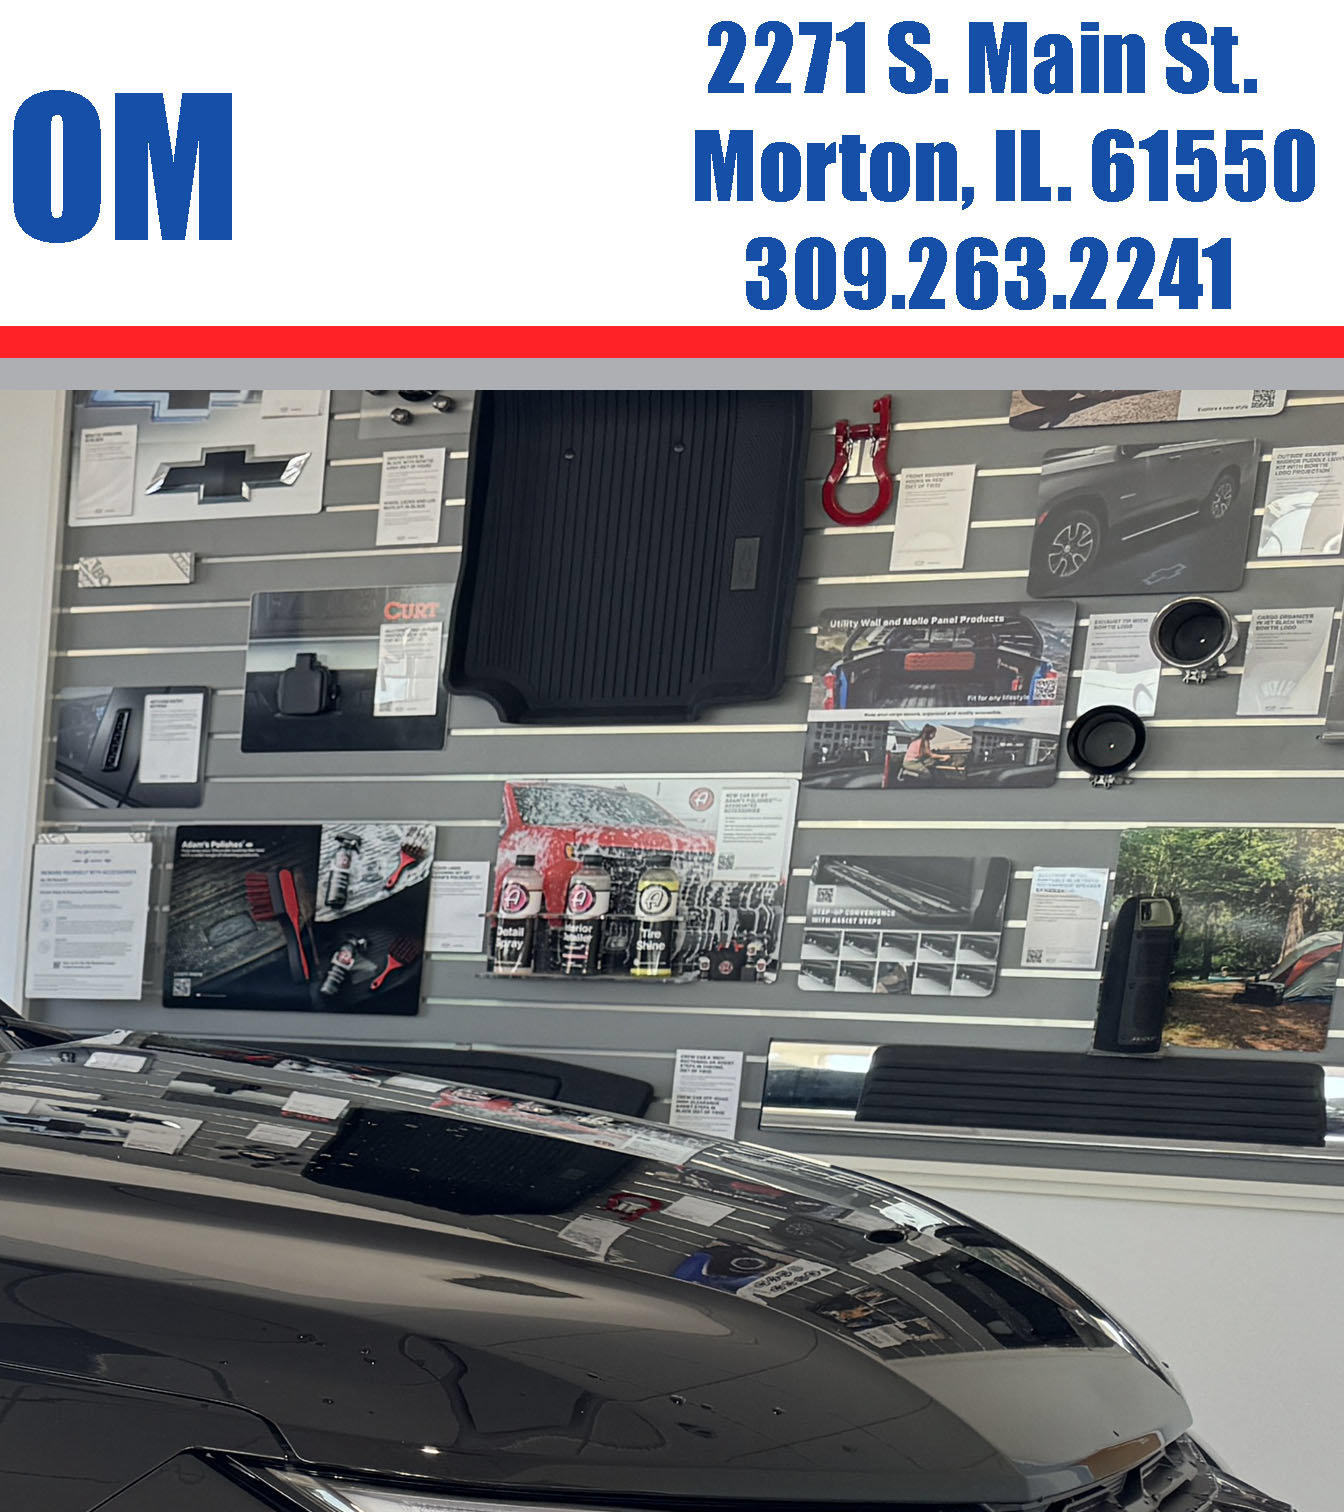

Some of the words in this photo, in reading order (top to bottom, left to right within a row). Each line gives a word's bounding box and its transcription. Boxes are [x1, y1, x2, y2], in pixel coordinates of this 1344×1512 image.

[384, 601, 440, 621] CURT
[830, 619, 859, 629] Utility
[861, 618, 881, 627] Wall
[883, 617, 901, 626] and
[903, 616, 929, 626] Molle
[931, 615, 958, 625] Panel
[959, 614, 1005, 624] Products
[181, 840, 210, 849] Adam's
[497, 926, 525, 937] Detail
[641, 928, 662, 939] Tire
[495, 939, 524, 951] Spray
[636, 940, 666, 951] Shine
